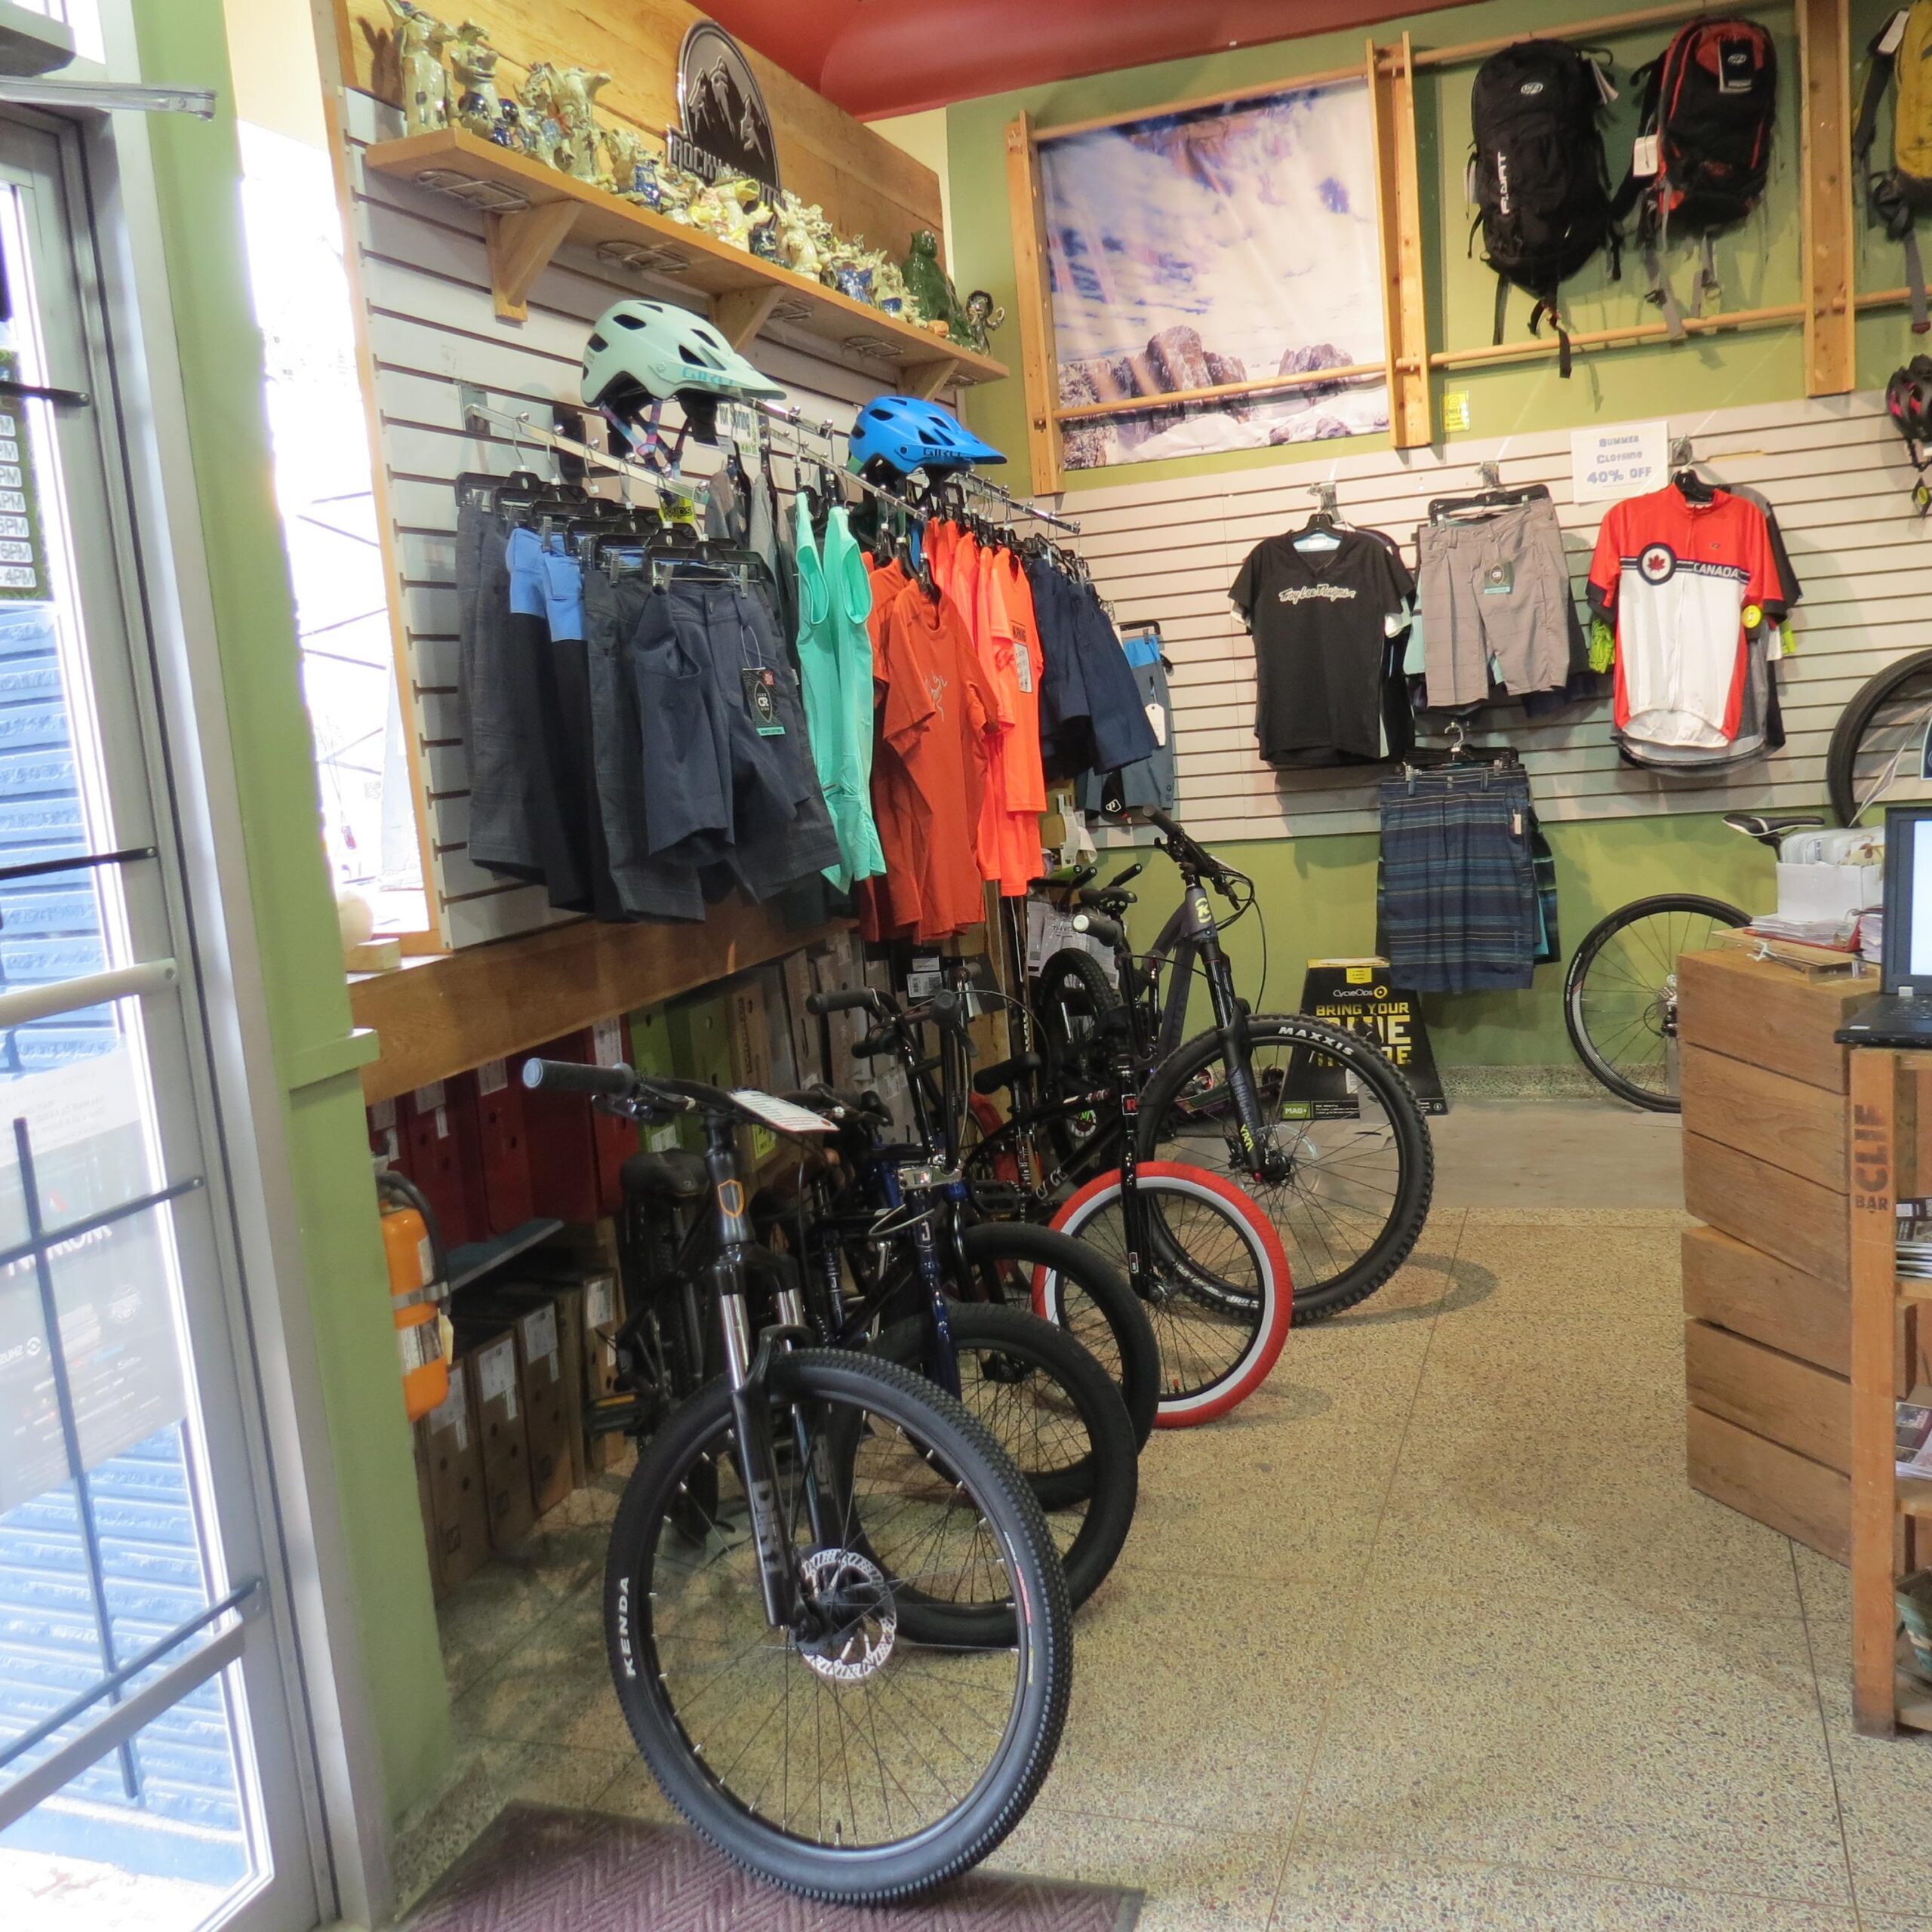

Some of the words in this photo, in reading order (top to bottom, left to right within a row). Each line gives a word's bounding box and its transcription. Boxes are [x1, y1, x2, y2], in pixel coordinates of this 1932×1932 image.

[672, 134, 718, 181] ROCKY
[1599, 435, 1639, 448] SUMMER
[1586, 469, 1624, 484] 40%
[1630, 466, 1653, 478] OFF
[1693, 562, 1741, 580] CANADA
[1333, 989, 1374, 998] CycleOps
[1315, 1004, 1362, 1017] BRING
[1367, 1002, 1410, 1014] YOUR
[1278, 1027, 1354, 1056] MAXXIS
[1854, 1104, 1888, 1192] CLIF
[1856, 1195, 1888, 1211] BAR
[619, 1577, 637, 1677] KENDA
